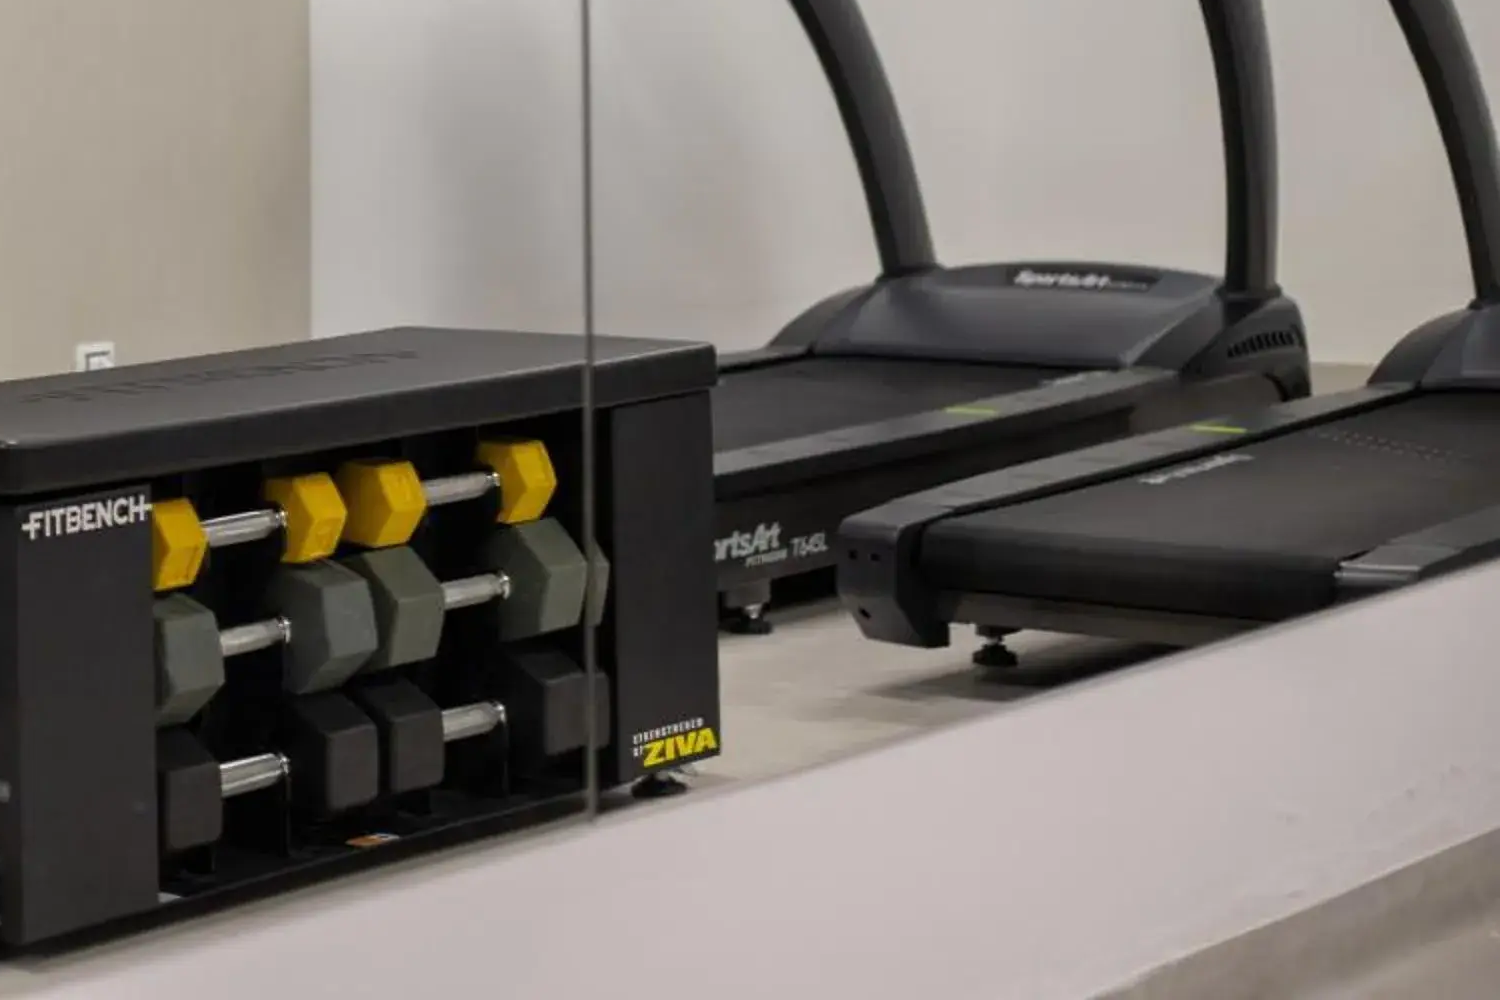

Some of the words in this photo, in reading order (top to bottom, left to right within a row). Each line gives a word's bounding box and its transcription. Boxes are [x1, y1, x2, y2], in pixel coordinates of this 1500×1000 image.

[21, 494, 153, 540] FITBENCH
[713, 521, 782, 561] rtsArt
[643, 727, 718, 768] ZIVA
